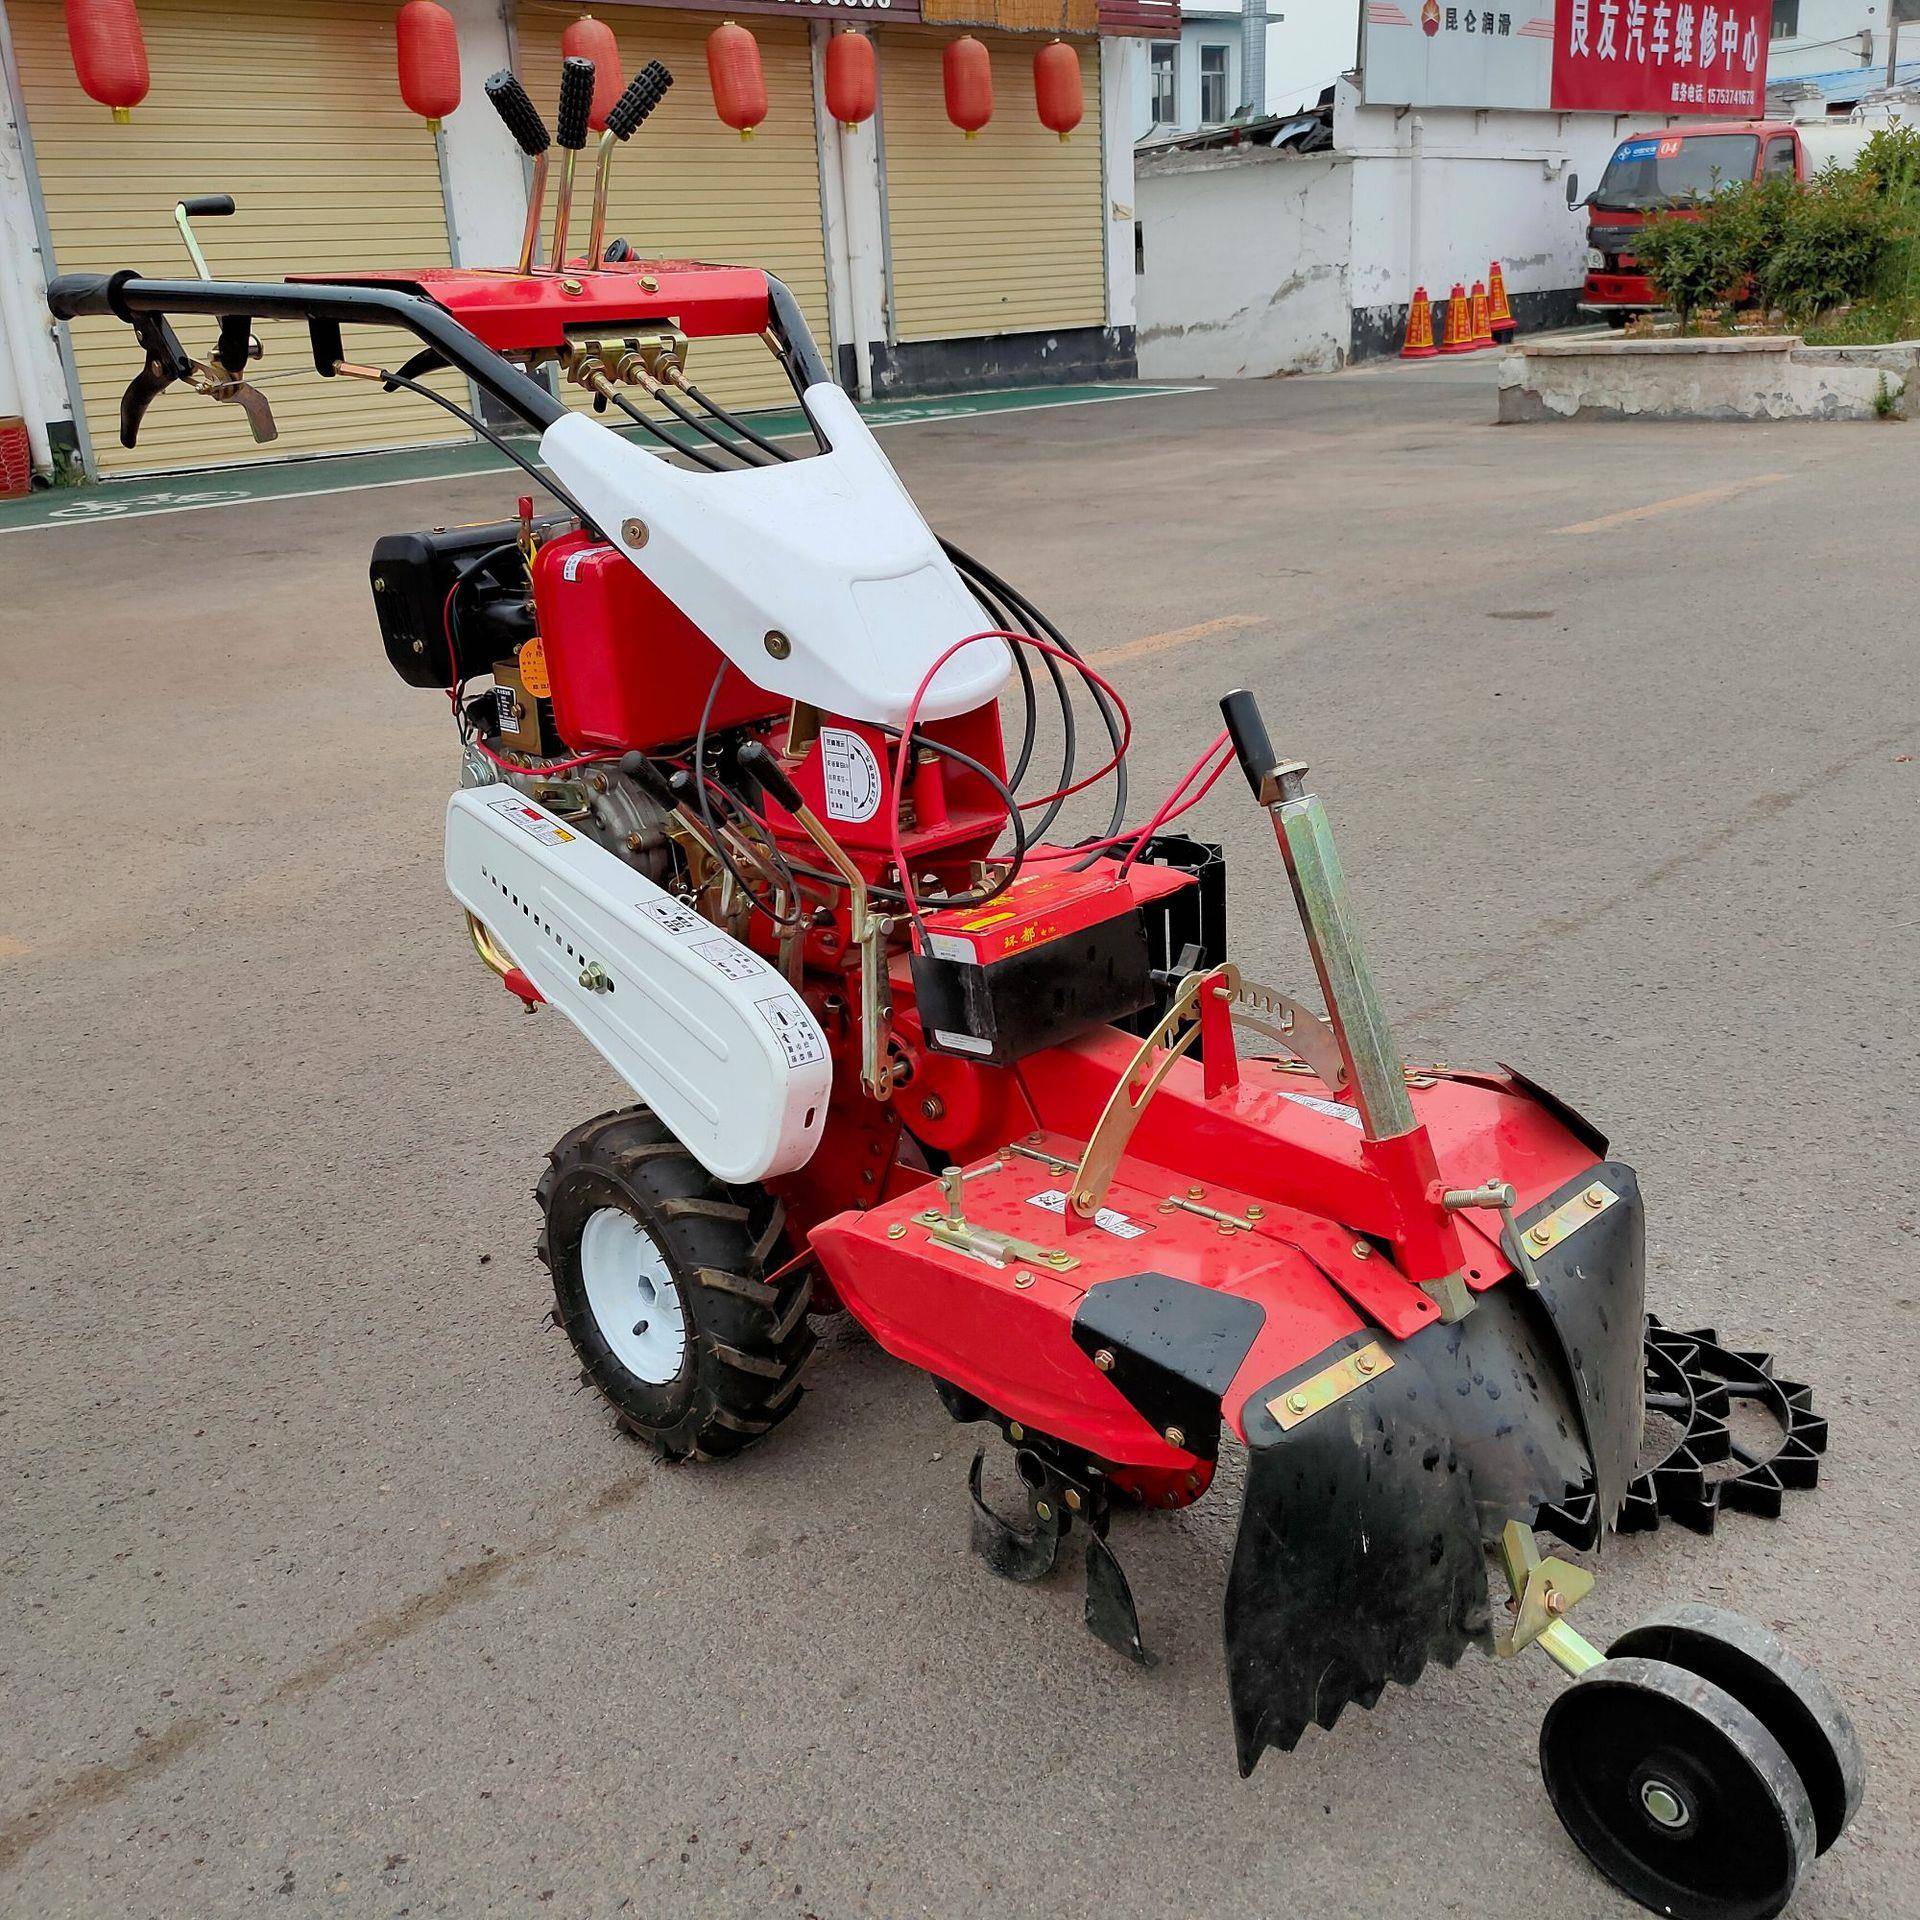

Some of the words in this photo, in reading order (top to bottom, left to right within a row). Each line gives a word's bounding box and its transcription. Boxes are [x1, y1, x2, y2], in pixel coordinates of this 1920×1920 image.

[1445, 7, 1511, 36] 昆仑润滑
[1570, 0, 1759, 72] 良友汽车维修中心
[1661, 142, 1678, 154] 04
